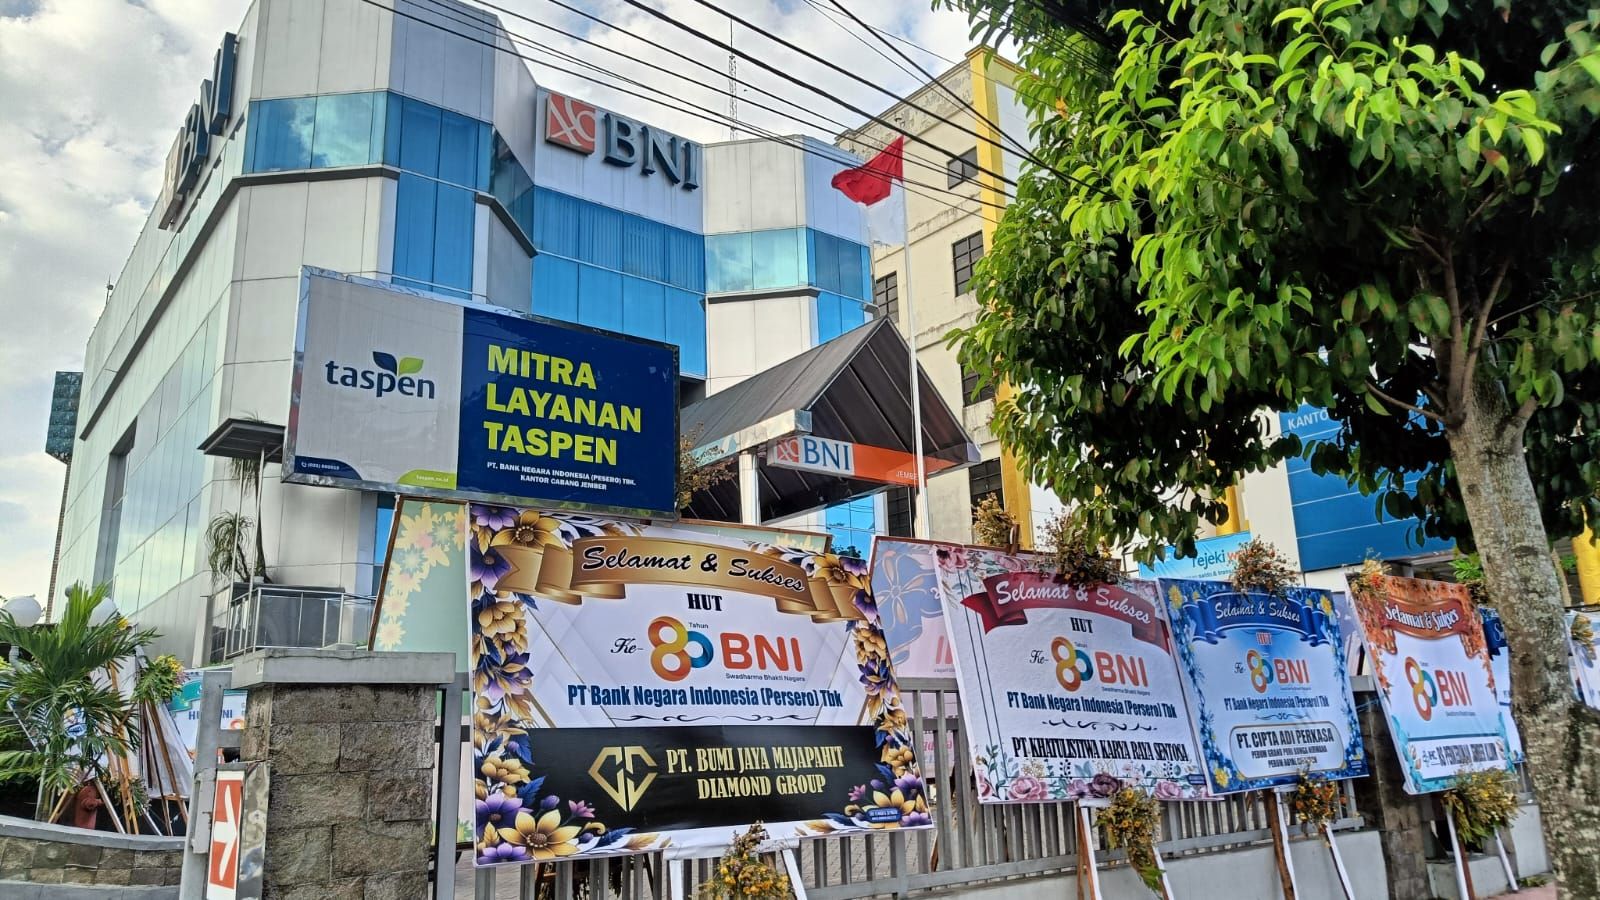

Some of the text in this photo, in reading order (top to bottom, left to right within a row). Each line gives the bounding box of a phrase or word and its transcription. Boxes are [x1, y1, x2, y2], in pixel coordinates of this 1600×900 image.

[603, 112, 699, 190] BNI
[325, 360, 435, 399] taspen
[487, 343, 597, 390] MITRA
[486, 382, 642, 433] LAYANAN
[1288, 411, 1329, 430] KANTO
[483, 421, 618, 466] TASPEN
[803, 437, 851, 471] BNI
[486, 461, 499, 470] PT.
[499, 463, 520, 472] BANK
[521, 465, 551, 475] NEGARA
[551, 469, 590, 481] INDONESIA
[520, 474, 607, 491] KANTOR CABANG JEMBER
[582, 545, 804, 592] Selamat & Sukses
[686, 592, 723, 611] HUT
[995, 579, 1151, 625] Selamat & Sukses
[1215, 601, 1300, 623] Selamat & Sukses
[688, 621, 709, 630] Tahun
[1070, 616, 1094, 634] HUT
[1384, 602, 1423, 629] Selamat
[648, 616, 714, 682] 80
[720, 632, 804, 672] BNI
[725, 672, 763, 681] Swadharma
[763, 673, 784, 681] Bhakti
[1095, 651, 1149, 688] BNI
[1274, 658, 1310, 684] BNI
[567, 684, 844, 708] PT Bank Negara Indonesia (Persero) Tbk
[1434, 669, 1473, 707] BNI
[1007, 691, 1178, 719] PT Bank Negara Indonesia (Persero) Tbk
[1223, 697, 1233, 711] PT
[1012, 736, 1028, 758] PT
[1100, 738, 1131, 760] KARYA
[1131, 741, 1153, 762] RAYA
[1153, 742, 1190, 763] SENTOSA
[1236, 727, 1335, 749] PT. CIPTA ADI PERKASA
[666, 745, 845, 774] PT. BUMI JAYA MAJAPAHIT
[697, 774, 827, 800] DIAMOND GROUP
